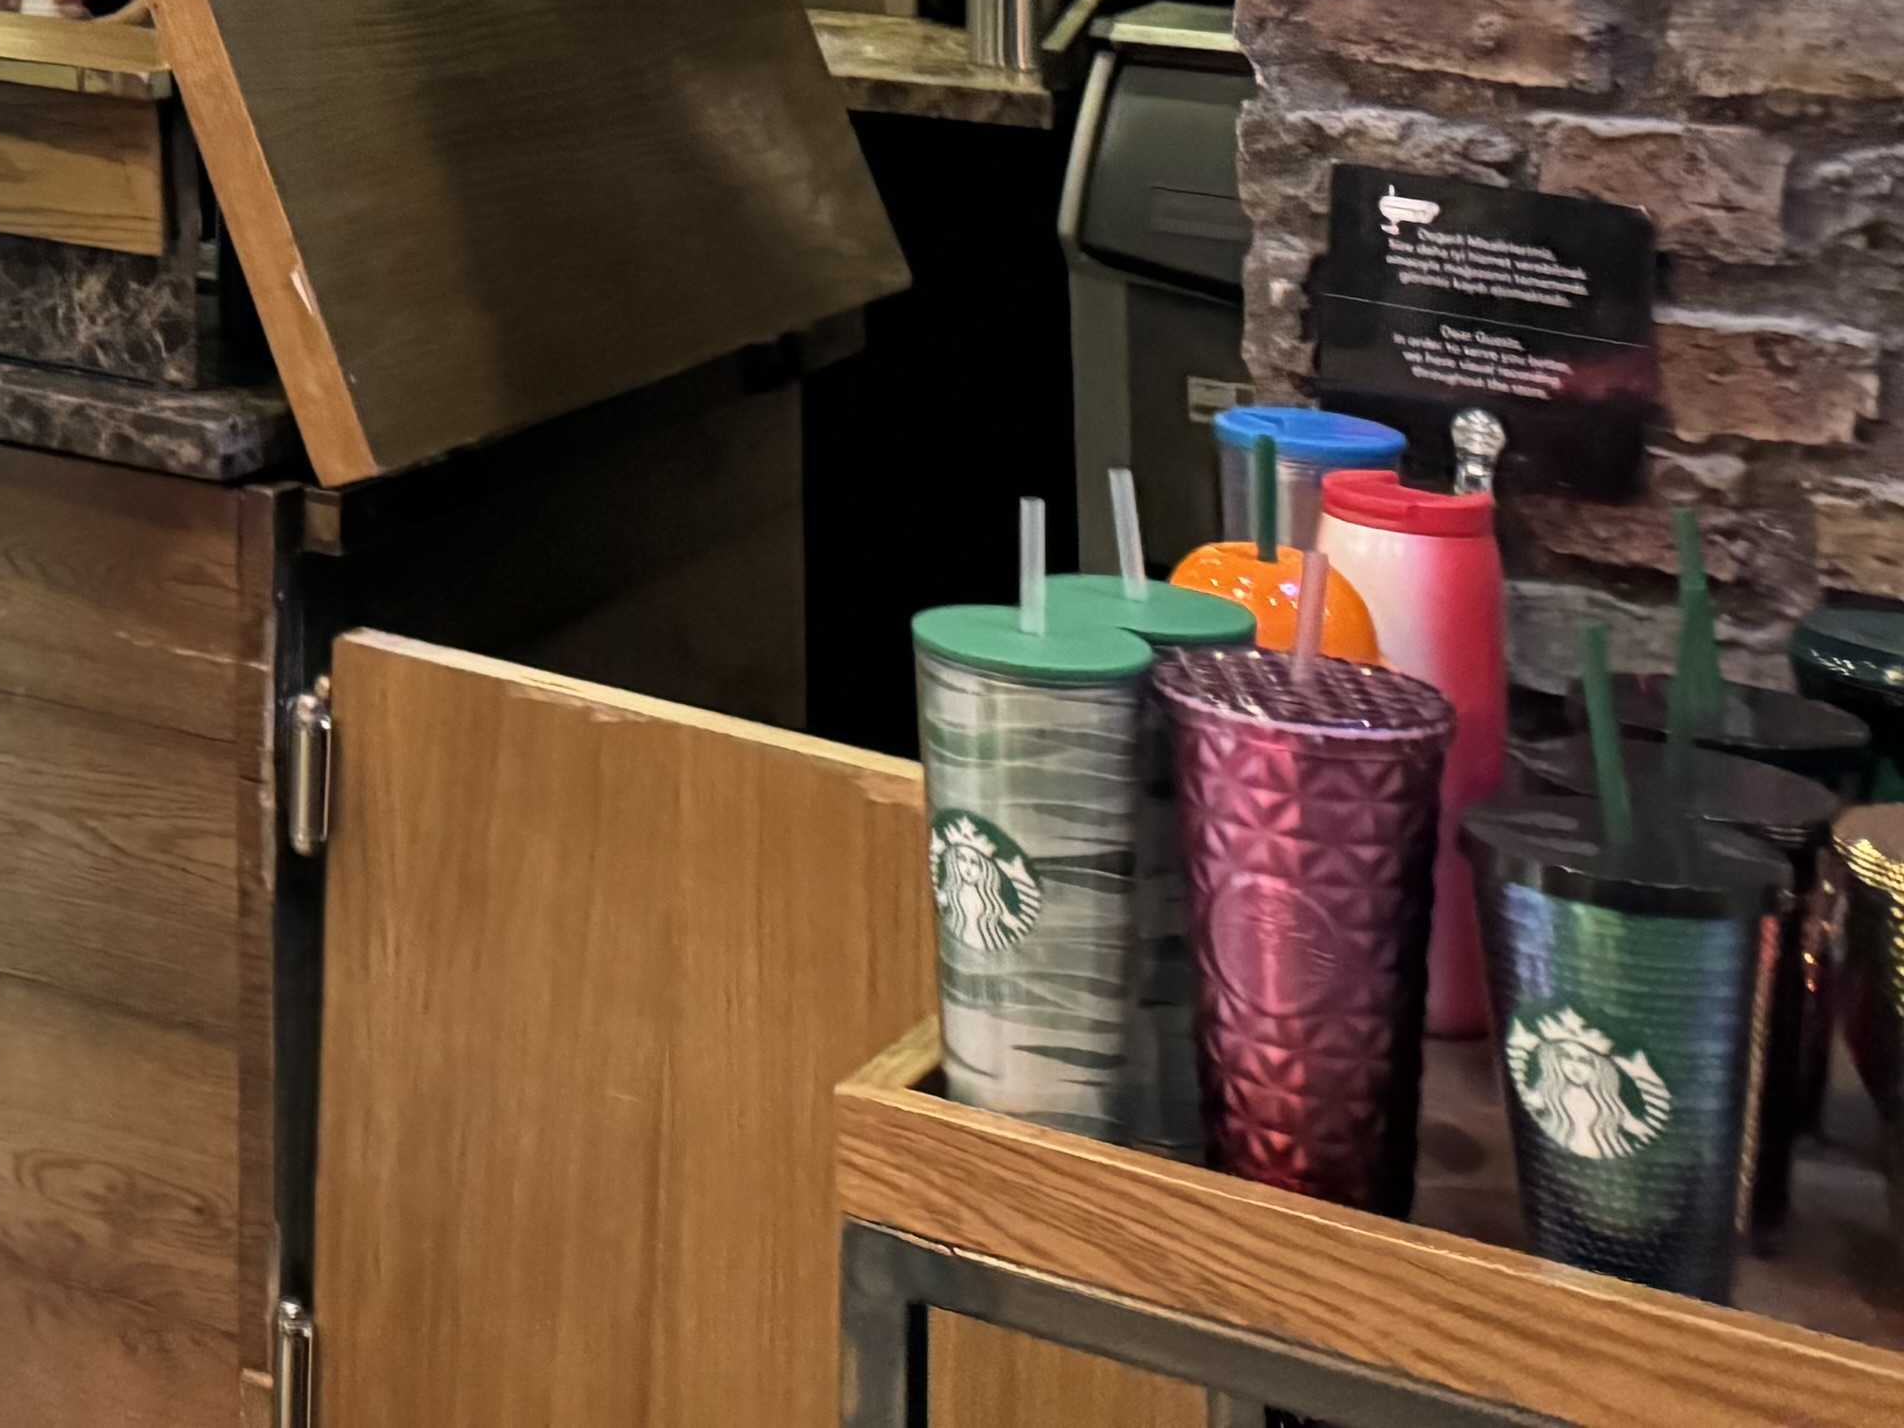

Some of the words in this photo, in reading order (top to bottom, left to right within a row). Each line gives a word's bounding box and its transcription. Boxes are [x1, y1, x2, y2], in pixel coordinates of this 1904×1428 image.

[1440, 323, 1473, 342] Dear
[1406, 335, 1443, 351] order
[1500, 350, 1527, 366] you
[1424, 350, 1458, 368] have
